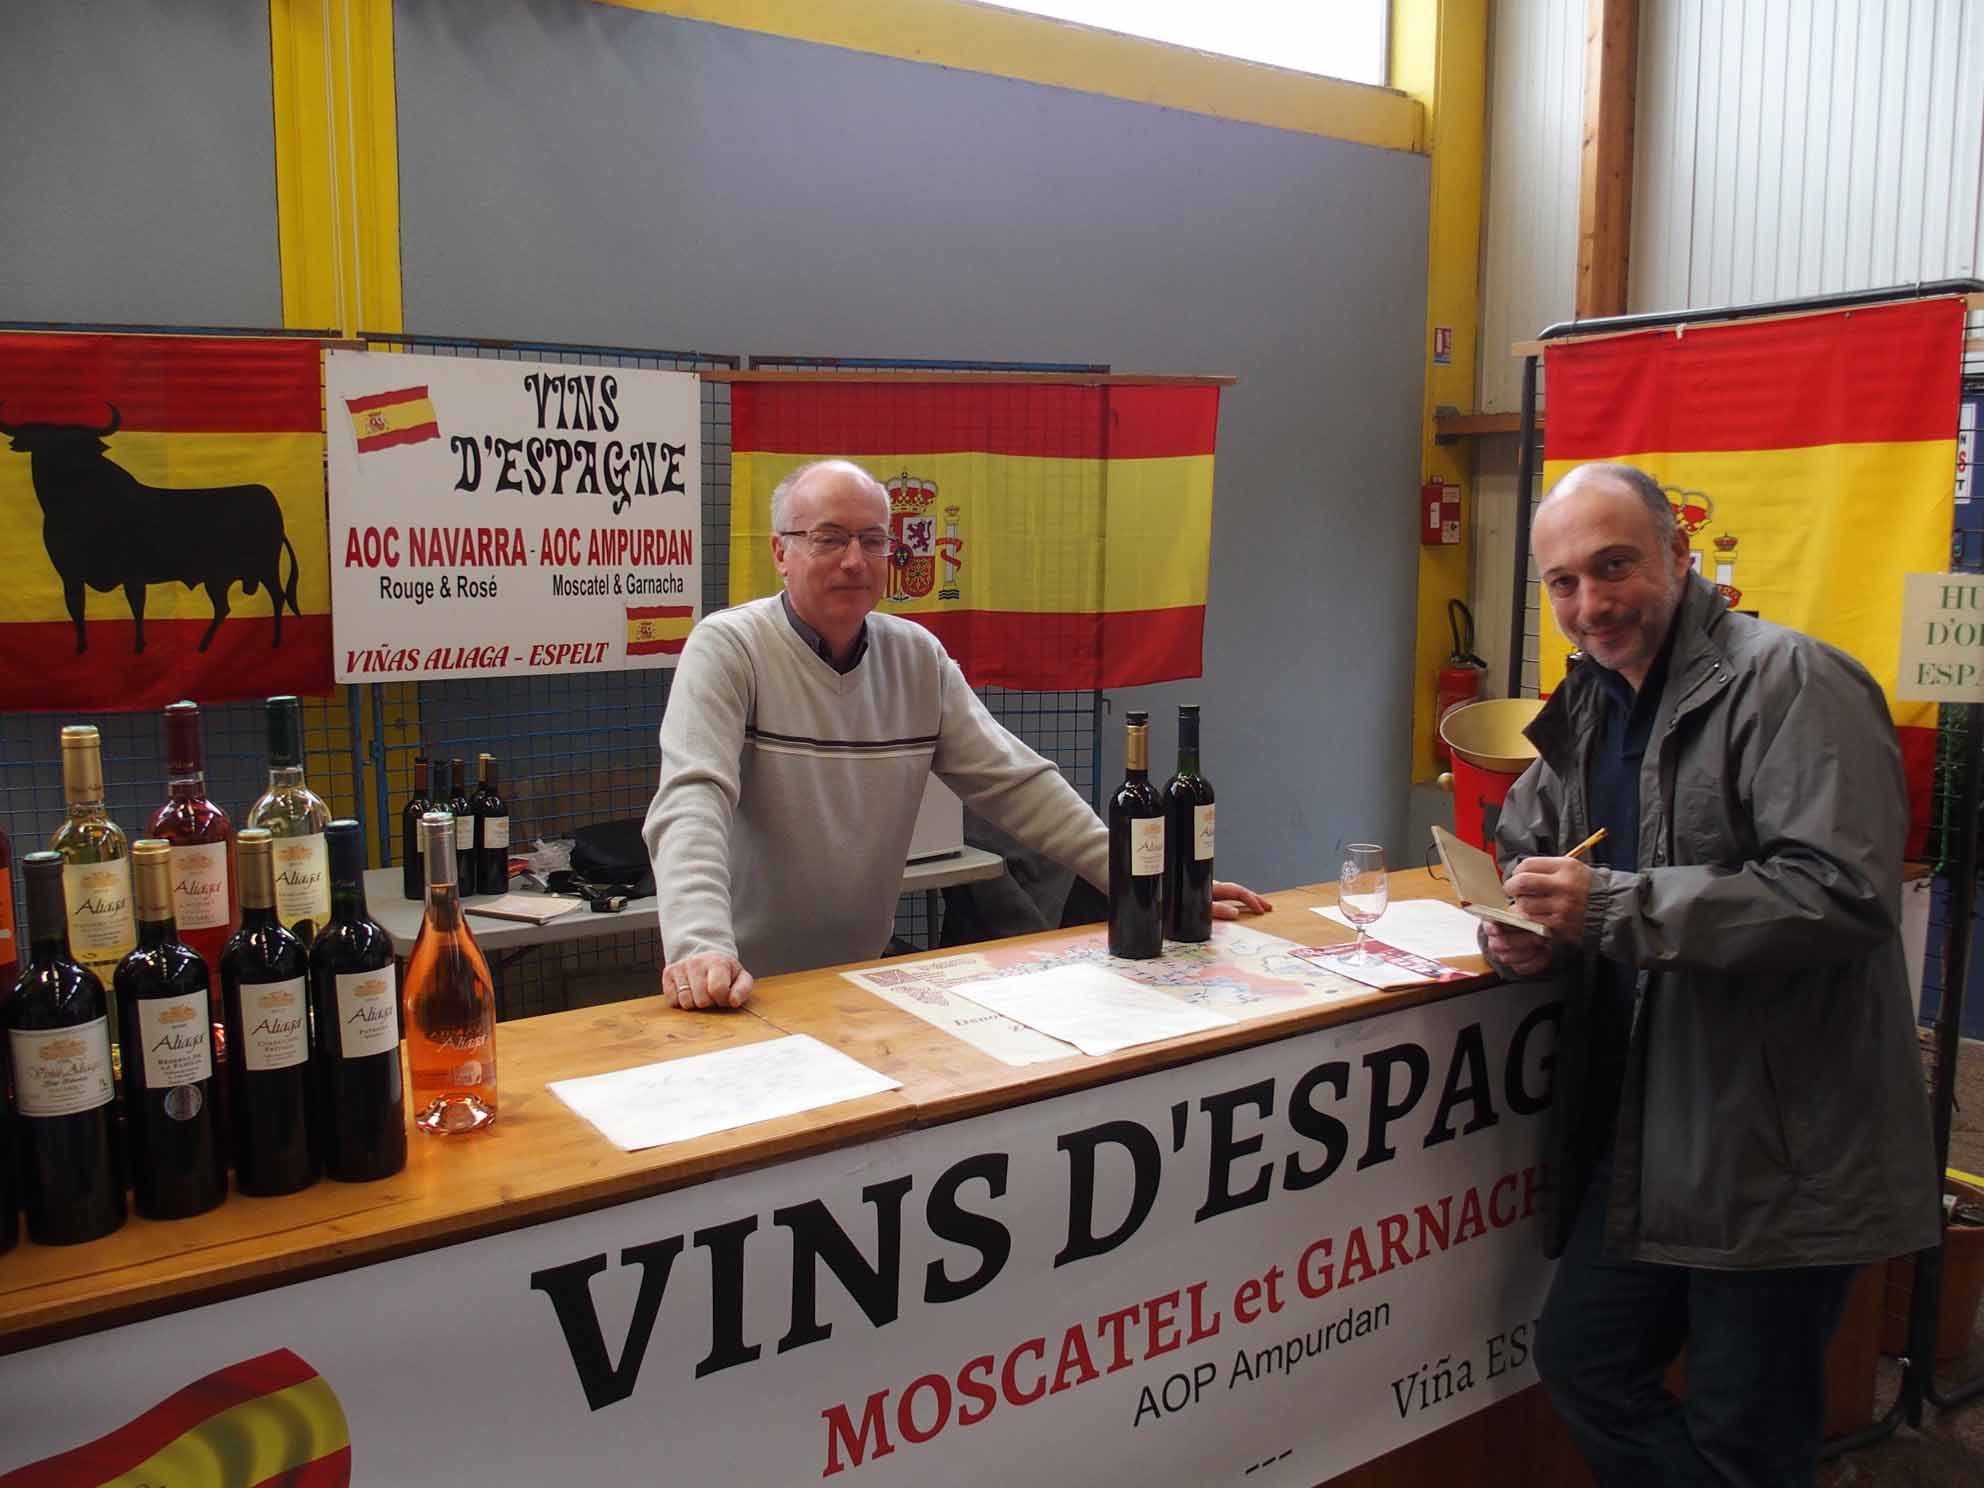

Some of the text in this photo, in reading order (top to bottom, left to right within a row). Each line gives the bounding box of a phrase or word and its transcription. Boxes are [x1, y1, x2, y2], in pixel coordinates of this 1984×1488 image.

[524, 373, 619, 432] VINS
[450, 435, 686, 515] D'ESPAGNE
[345, 527, 400, 567] AOC
[409, 527, 527, 567] NAVARRA
[540, 528, 581, 566] AOC
[587, 528, 693, 566] AMPURDAN
[380, 574, 497, 604] Rouge & Rosé
[553, 572, 683, 596] Moscatel & Garnacha
[346, 644, 418, 673] VIÑAS
[424, 645, 510, 670] ALIAGA
[529, 642, 609, 666] ESPELT
[530, 1151, 1011, 1413] VINS
[822, 1281, 1221, 1477] MOSCATEL
[1234, 1265, 1284, 1323] et
[1134, 1302, 1391, 1428] AOP Ampurdan
[1391, 1319, 1540, 1419] Viña ES
